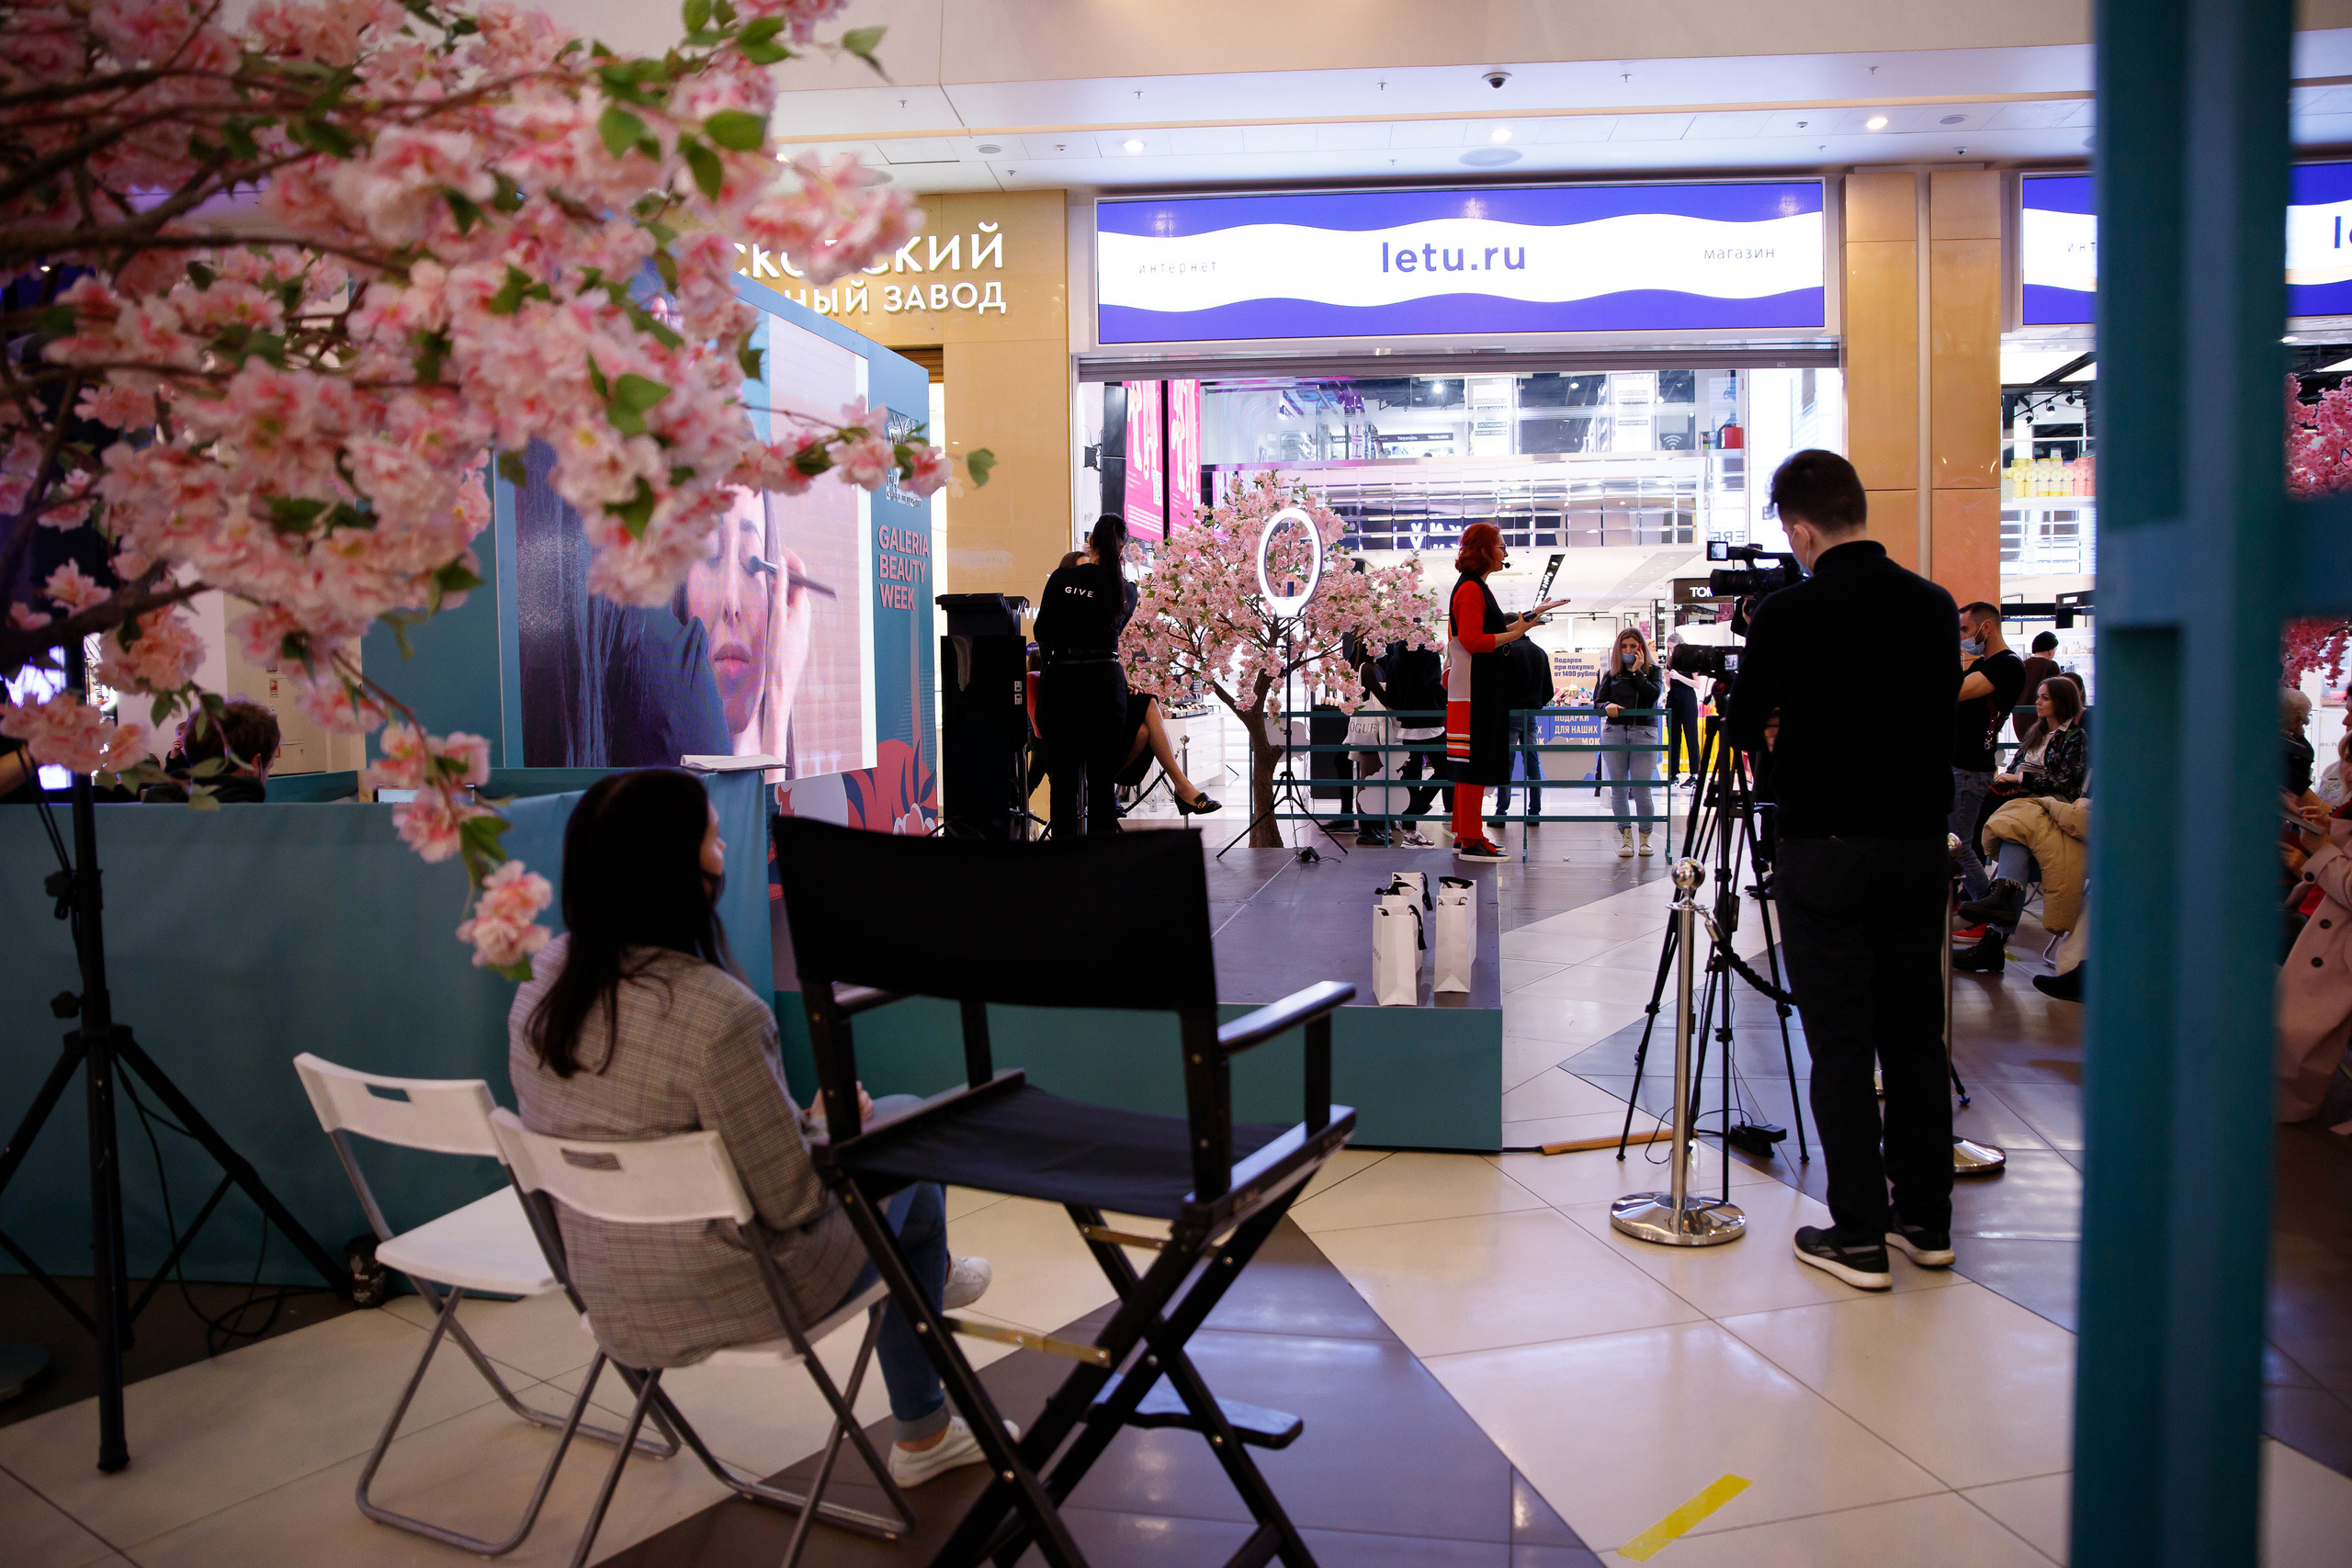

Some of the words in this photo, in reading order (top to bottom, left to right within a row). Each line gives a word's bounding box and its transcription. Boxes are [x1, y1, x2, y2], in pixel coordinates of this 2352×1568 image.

[1382, 242, 1526, 273] letu.ru
[1703, 248, 1775, 259] магазин
[1138, 261, 1216, 276] интернет
[883, 281, 1007, 315] ЗАВОД
[878, 525, 930, 558] GALERIA
[878, 554, 926, 584] BEAUTY
[878, 583, 916, 611] WEEK
[1065, 586, 1093, 598] GIVE
[1555, 725, 1570, 735] ДЛЯ
[1571, 725, 1599, 734] НАШИХ
